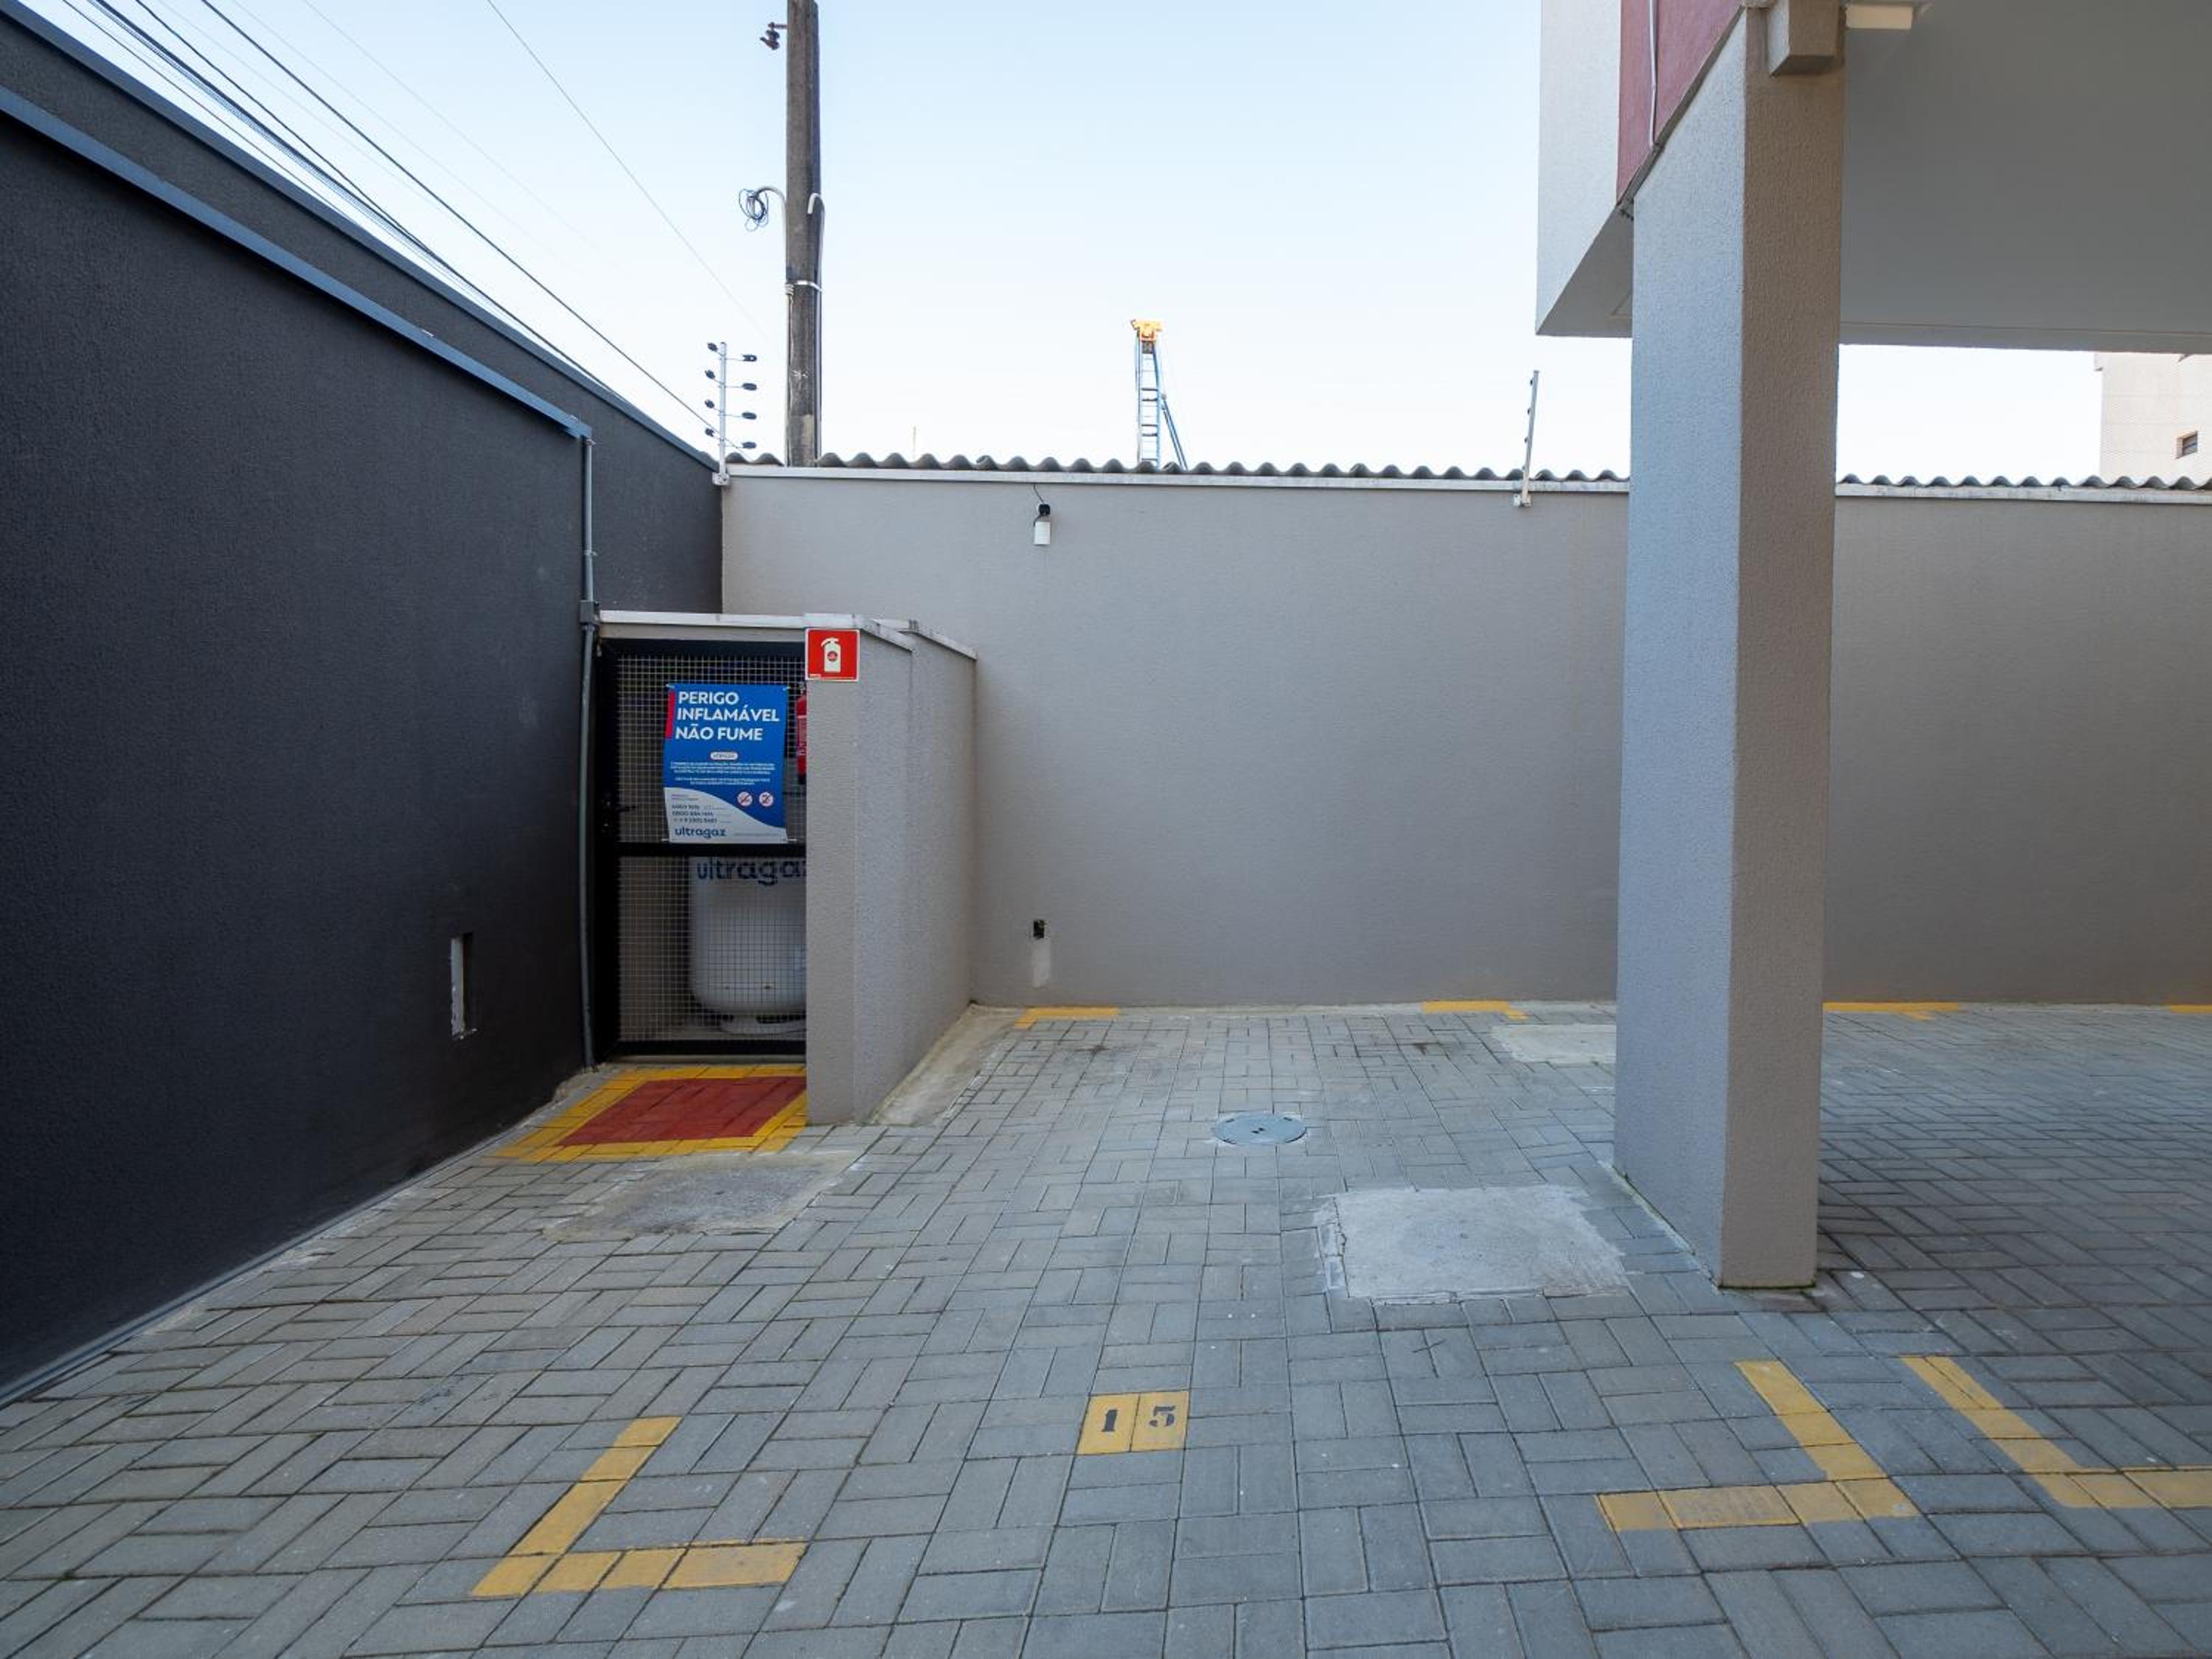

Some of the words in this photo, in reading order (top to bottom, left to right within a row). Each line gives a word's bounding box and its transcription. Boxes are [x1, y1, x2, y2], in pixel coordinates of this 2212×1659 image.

[678, 692, 739, 705] PERIGO
[677, 706, 779, 722] INFLAMÁVEL
[675, 724, 714, 740] NÃO
[717, 728, 763, 741] FUME
[674, 827, 726, 838] ultragaz
